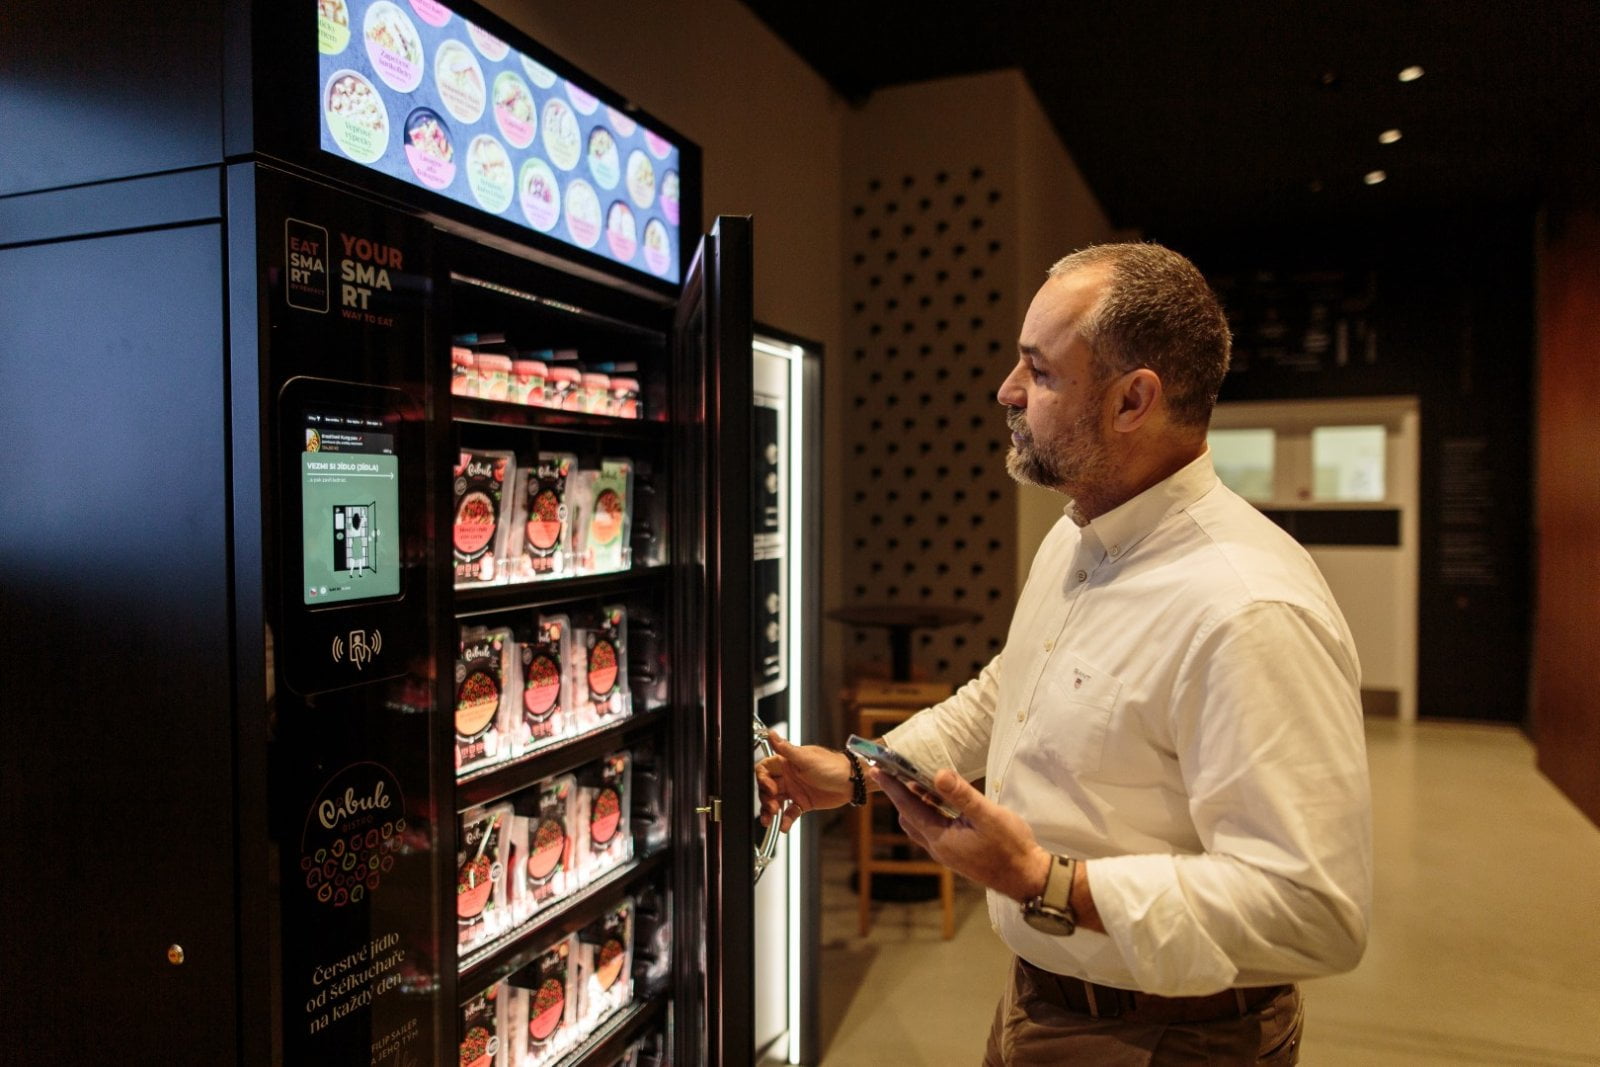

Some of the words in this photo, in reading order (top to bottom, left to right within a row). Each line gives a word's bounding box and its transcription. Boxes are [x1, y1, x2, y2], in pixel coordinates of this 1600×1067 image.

[290, 237, 319, 256] EAT
[340, 232, 403, 270] YOUR
[290, 252, 325, 273] SMA
[290, 268, 311, 284] RT
[341, 259, 392, 292] SMA
[342, 284, 372, 310] RT
[341, 309, 362, 320] WAY
[364, 313, 376, 323] TO
[377, 316, 394, 327] EAT
[306, 462, 328, 470] VEZMI
[312, 945, 367, 985] Čerstvé
[370, 932, 399, 959] jídlo
[306, 990, 326, 1013] od
[330, 949, 405, 1000] šéfkuchaře
[310, 1013, 329, 1034] na
[333, 983, 374, 1021] každý
[376, 972, 402, 995] den
[378, 1041, 400, 1061] JEHO
